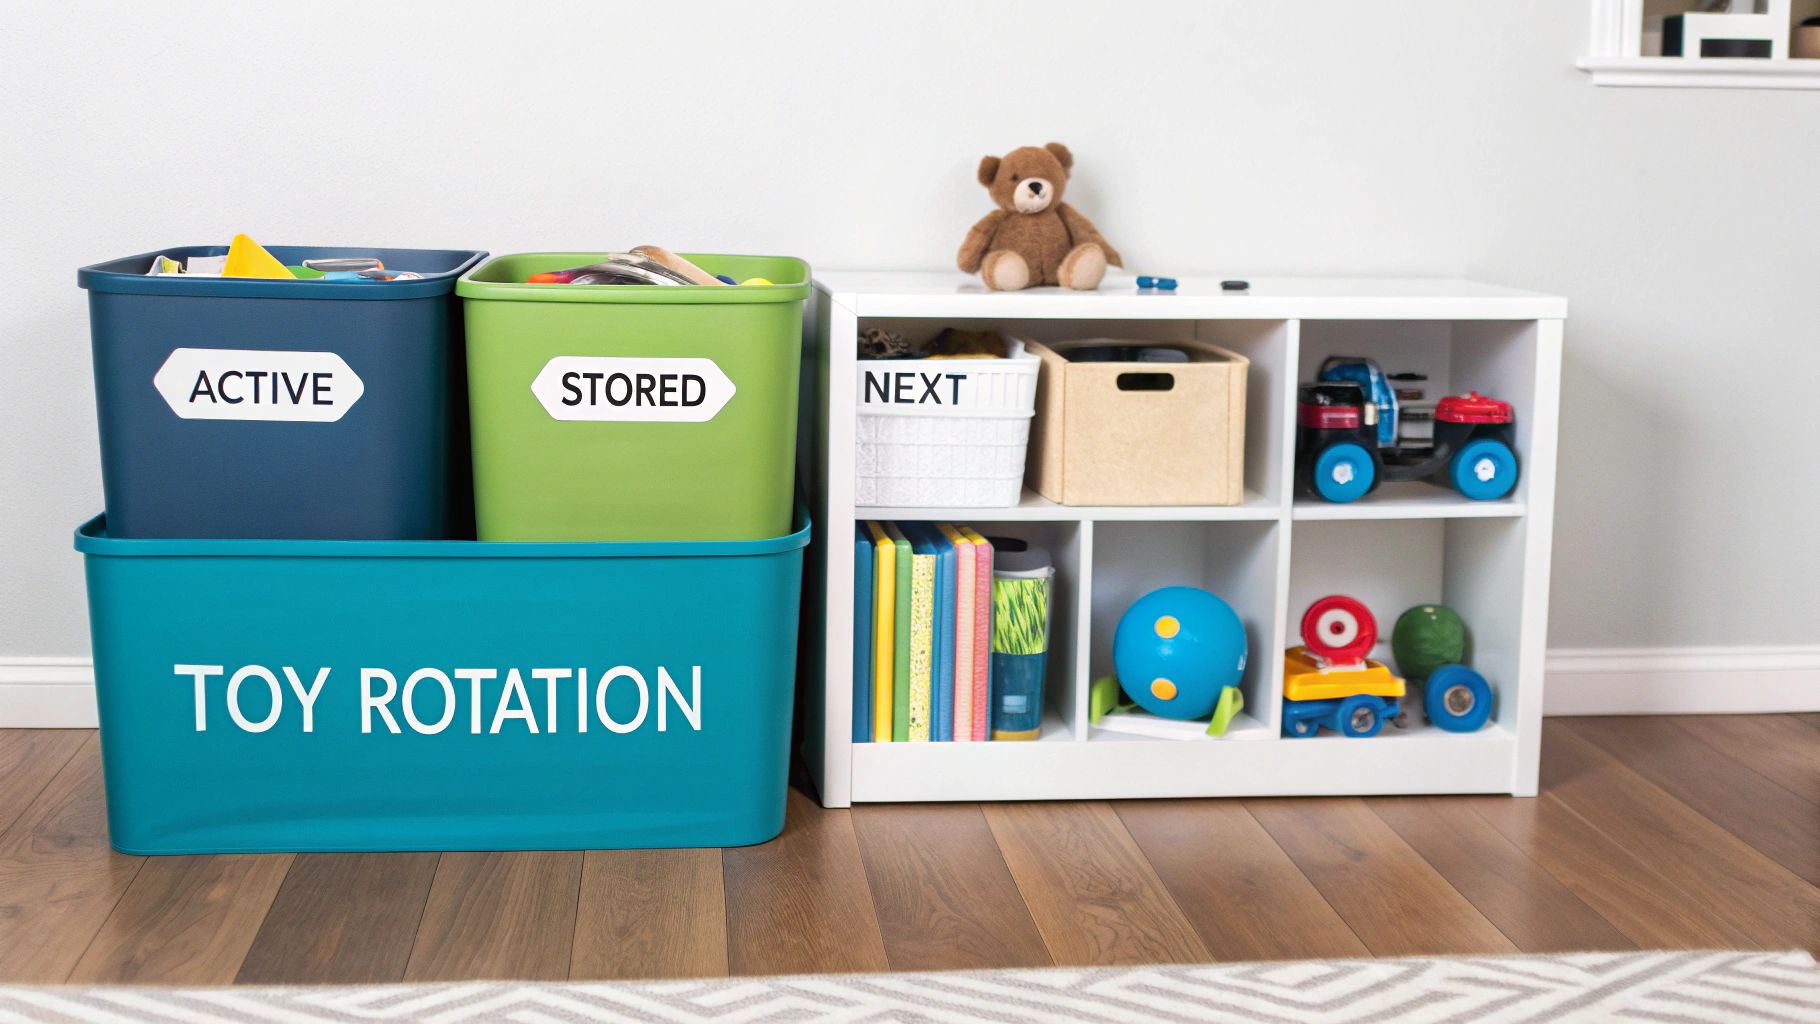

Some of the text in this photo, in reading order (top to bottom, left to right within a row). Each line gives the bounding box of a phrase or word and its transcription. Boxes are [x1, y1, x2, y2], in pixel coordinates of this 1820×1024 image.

[189, 370, 334, 406] ACTIVE
[561, 371, 707, 407] STORED
[864, 370, 967, 406] NEXT
[174, 664, 702, 735] TOY ROTATION
